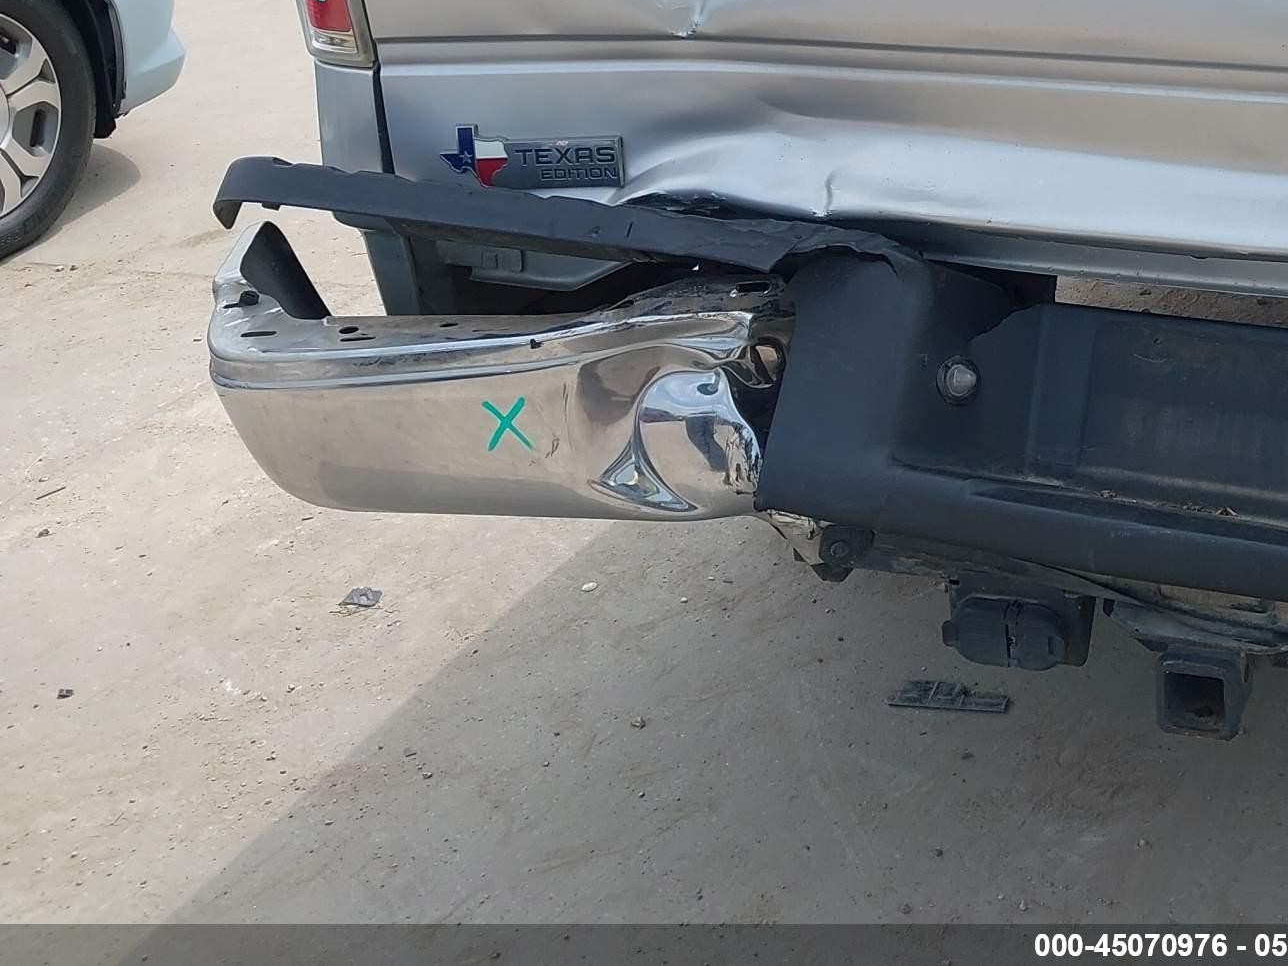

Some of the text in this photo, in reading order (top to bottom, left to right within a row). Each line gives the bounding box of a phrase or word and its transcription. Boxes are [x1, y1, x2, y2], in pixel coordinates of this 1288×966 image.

[514, 145, 615, 167] TEXAS
[539, 166, 619, 182] EDITION
[481, 395, 534, 453] X
